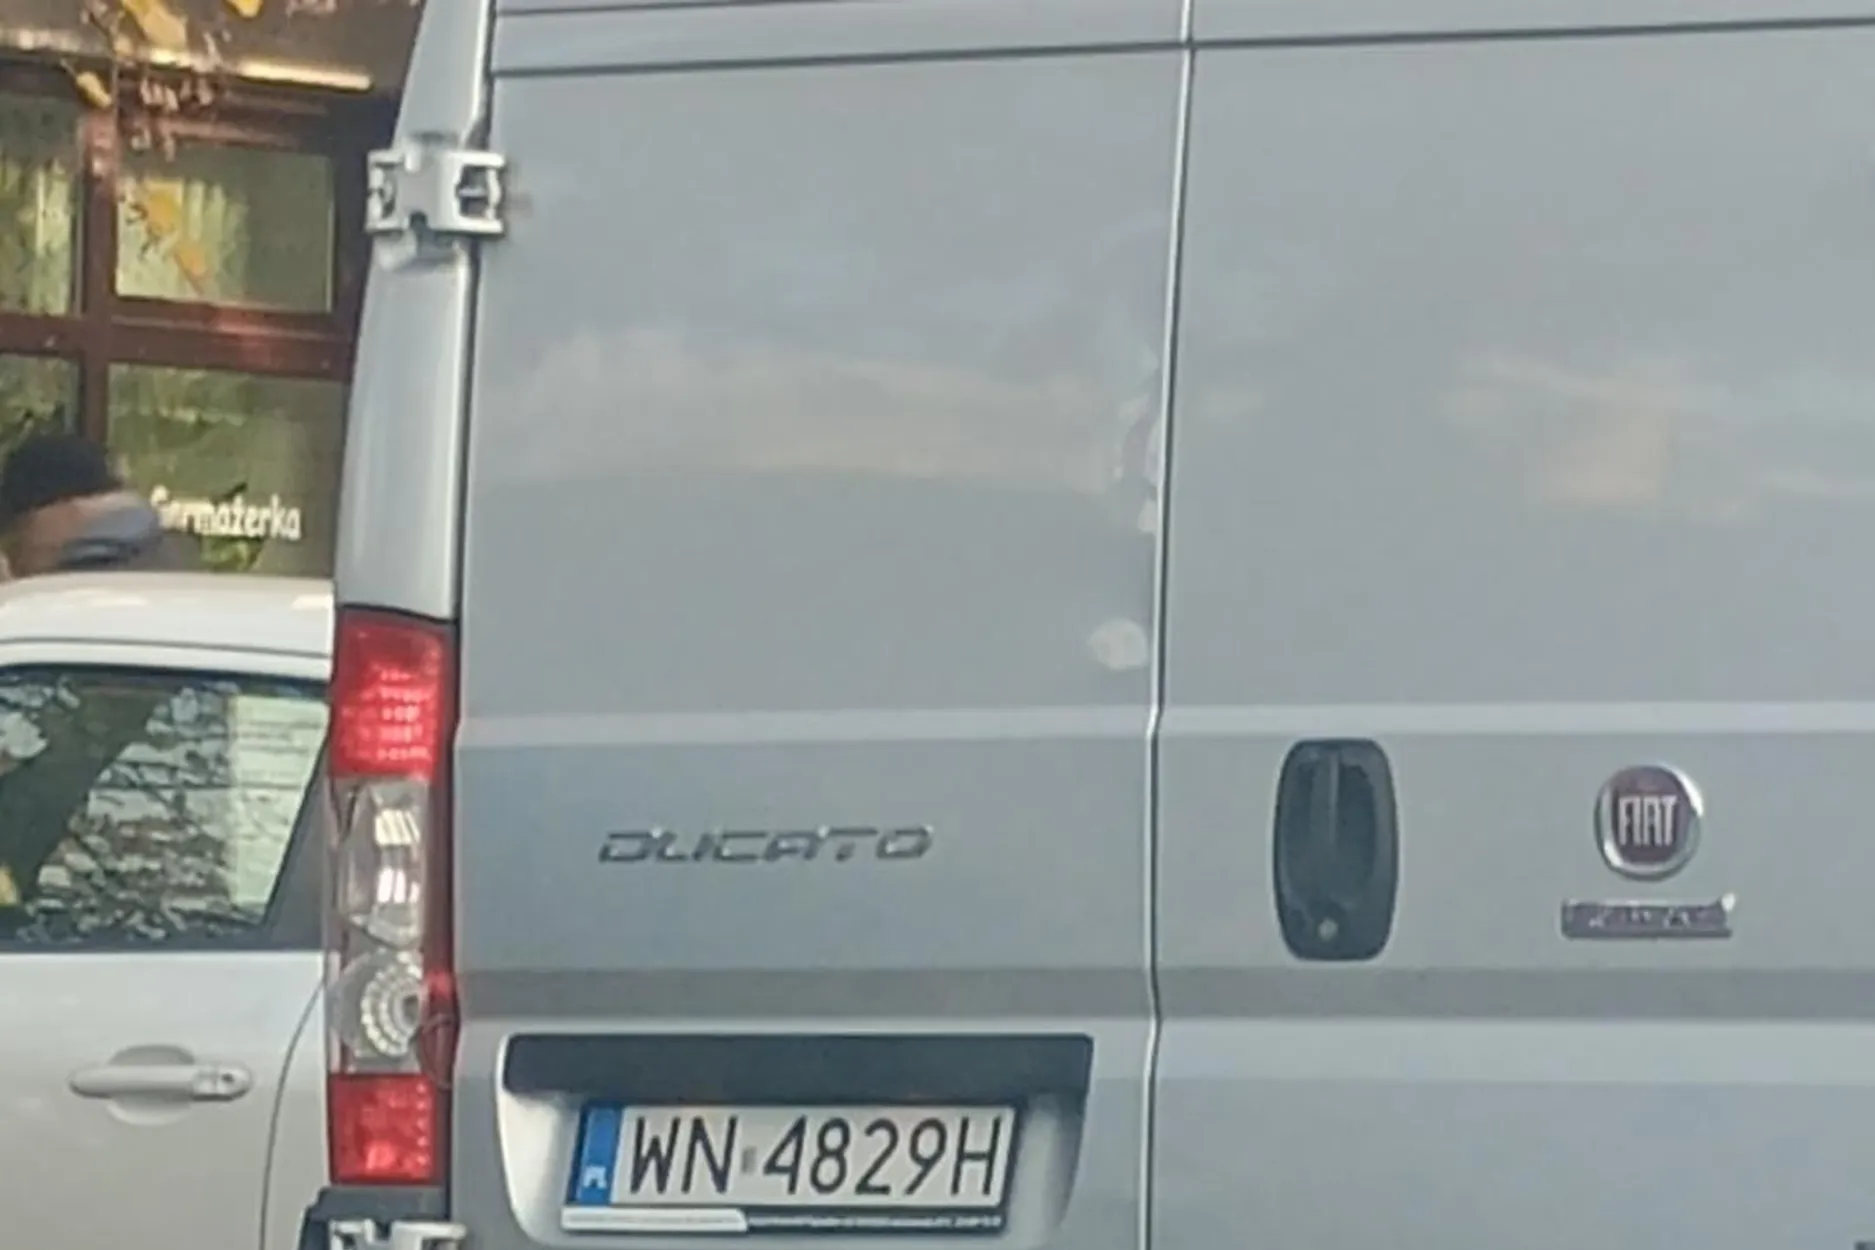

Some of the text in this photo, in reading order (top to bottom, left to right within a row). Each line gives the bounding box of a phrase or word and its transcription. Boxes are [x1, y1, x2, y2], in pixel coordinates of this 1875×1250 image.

[598, 826, 934, 864] DUCATO
[1618, 795, 1675, 846] FIAT
[630, 1114, 1002, 1196] WN 4829H
